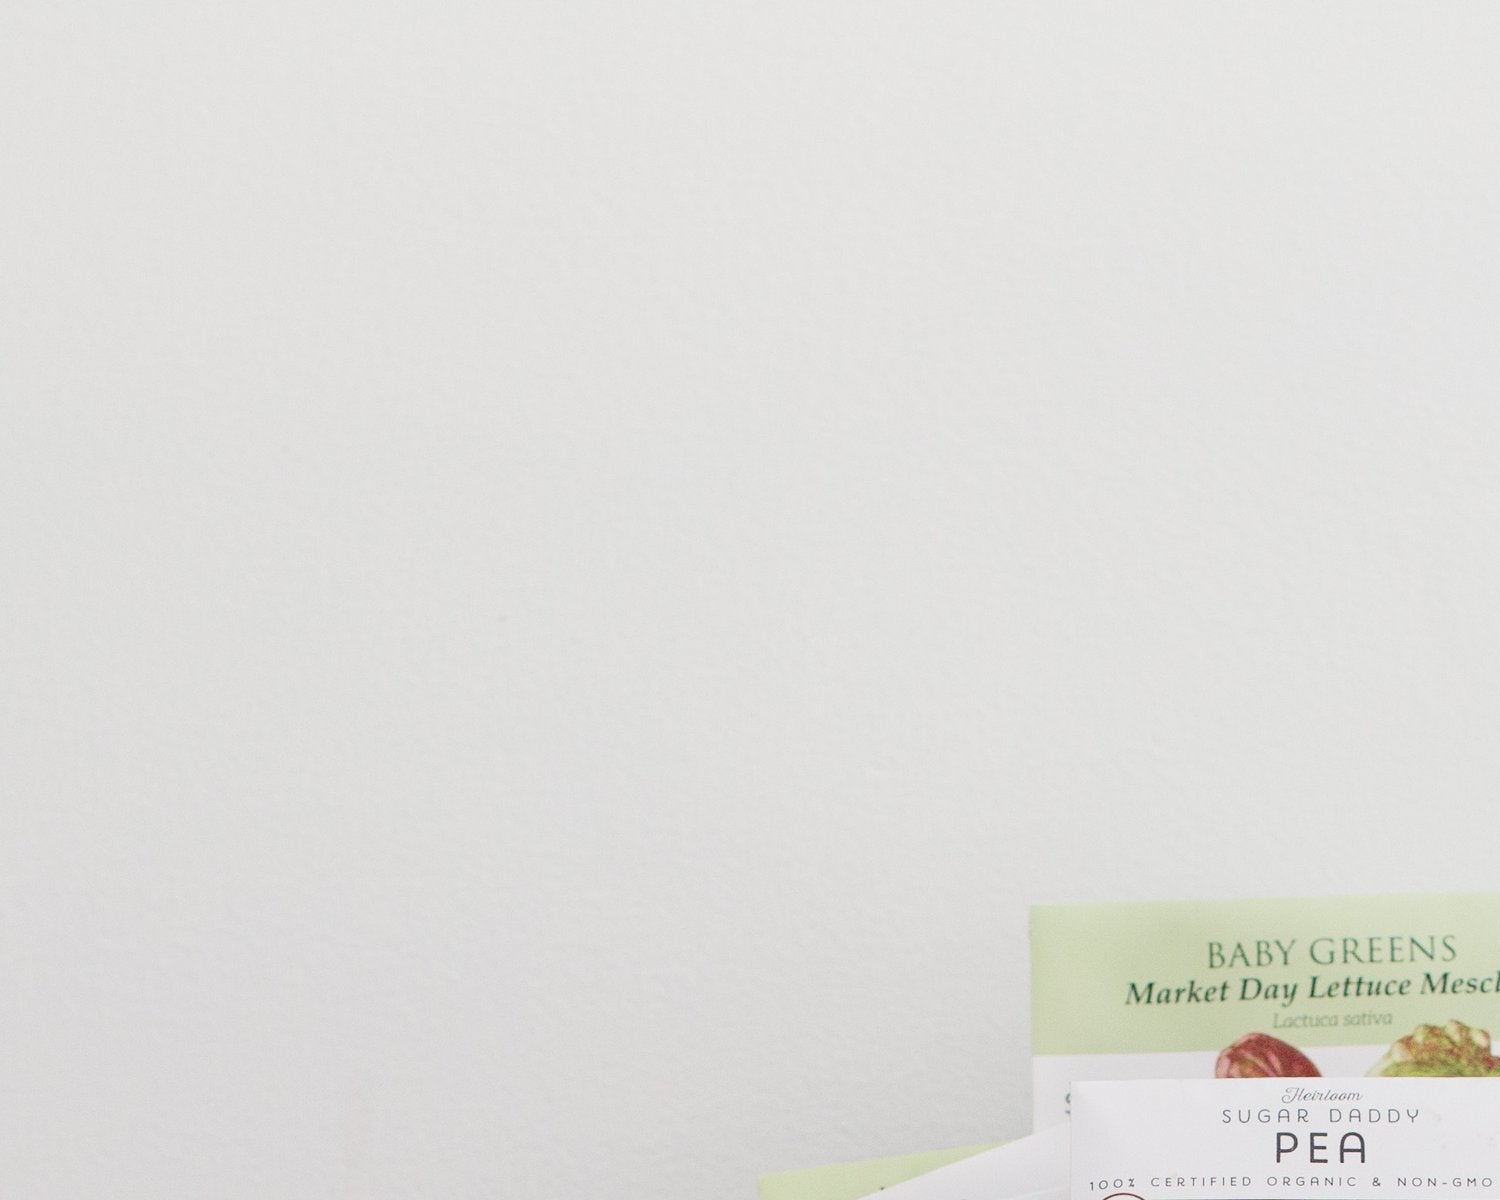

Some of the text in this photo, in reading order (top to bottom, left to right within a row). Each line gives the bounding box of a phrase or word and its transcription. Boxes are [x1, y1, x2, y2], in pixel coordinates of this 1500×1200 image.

[1208, 935, 1458, 969] BABY GREENS
[1126, 980, 1229, 1005] Market
[1240, 977, 1298, 1007] Day
[1308, 972, 1412, 999] Lettuce
[1273, 1011, 1394, 1029] Lactuca sativa
[1281, 1087, 1362, 1104] Heirloom
[1222, 1108, 1420, 1124] SUGAR DADDY
[1276, 1132, 1366, 1164] PEA
[1089, 1178, 1136, 1192] 100%
[1150, 1176, 1252, 1187] CERTIFIED
[1266, 1176, 1356, 1187] ORGANIC
[1372, 1177, 1382, 1187] &
[1397, 1177, 1493, 1188] NON-GMO
